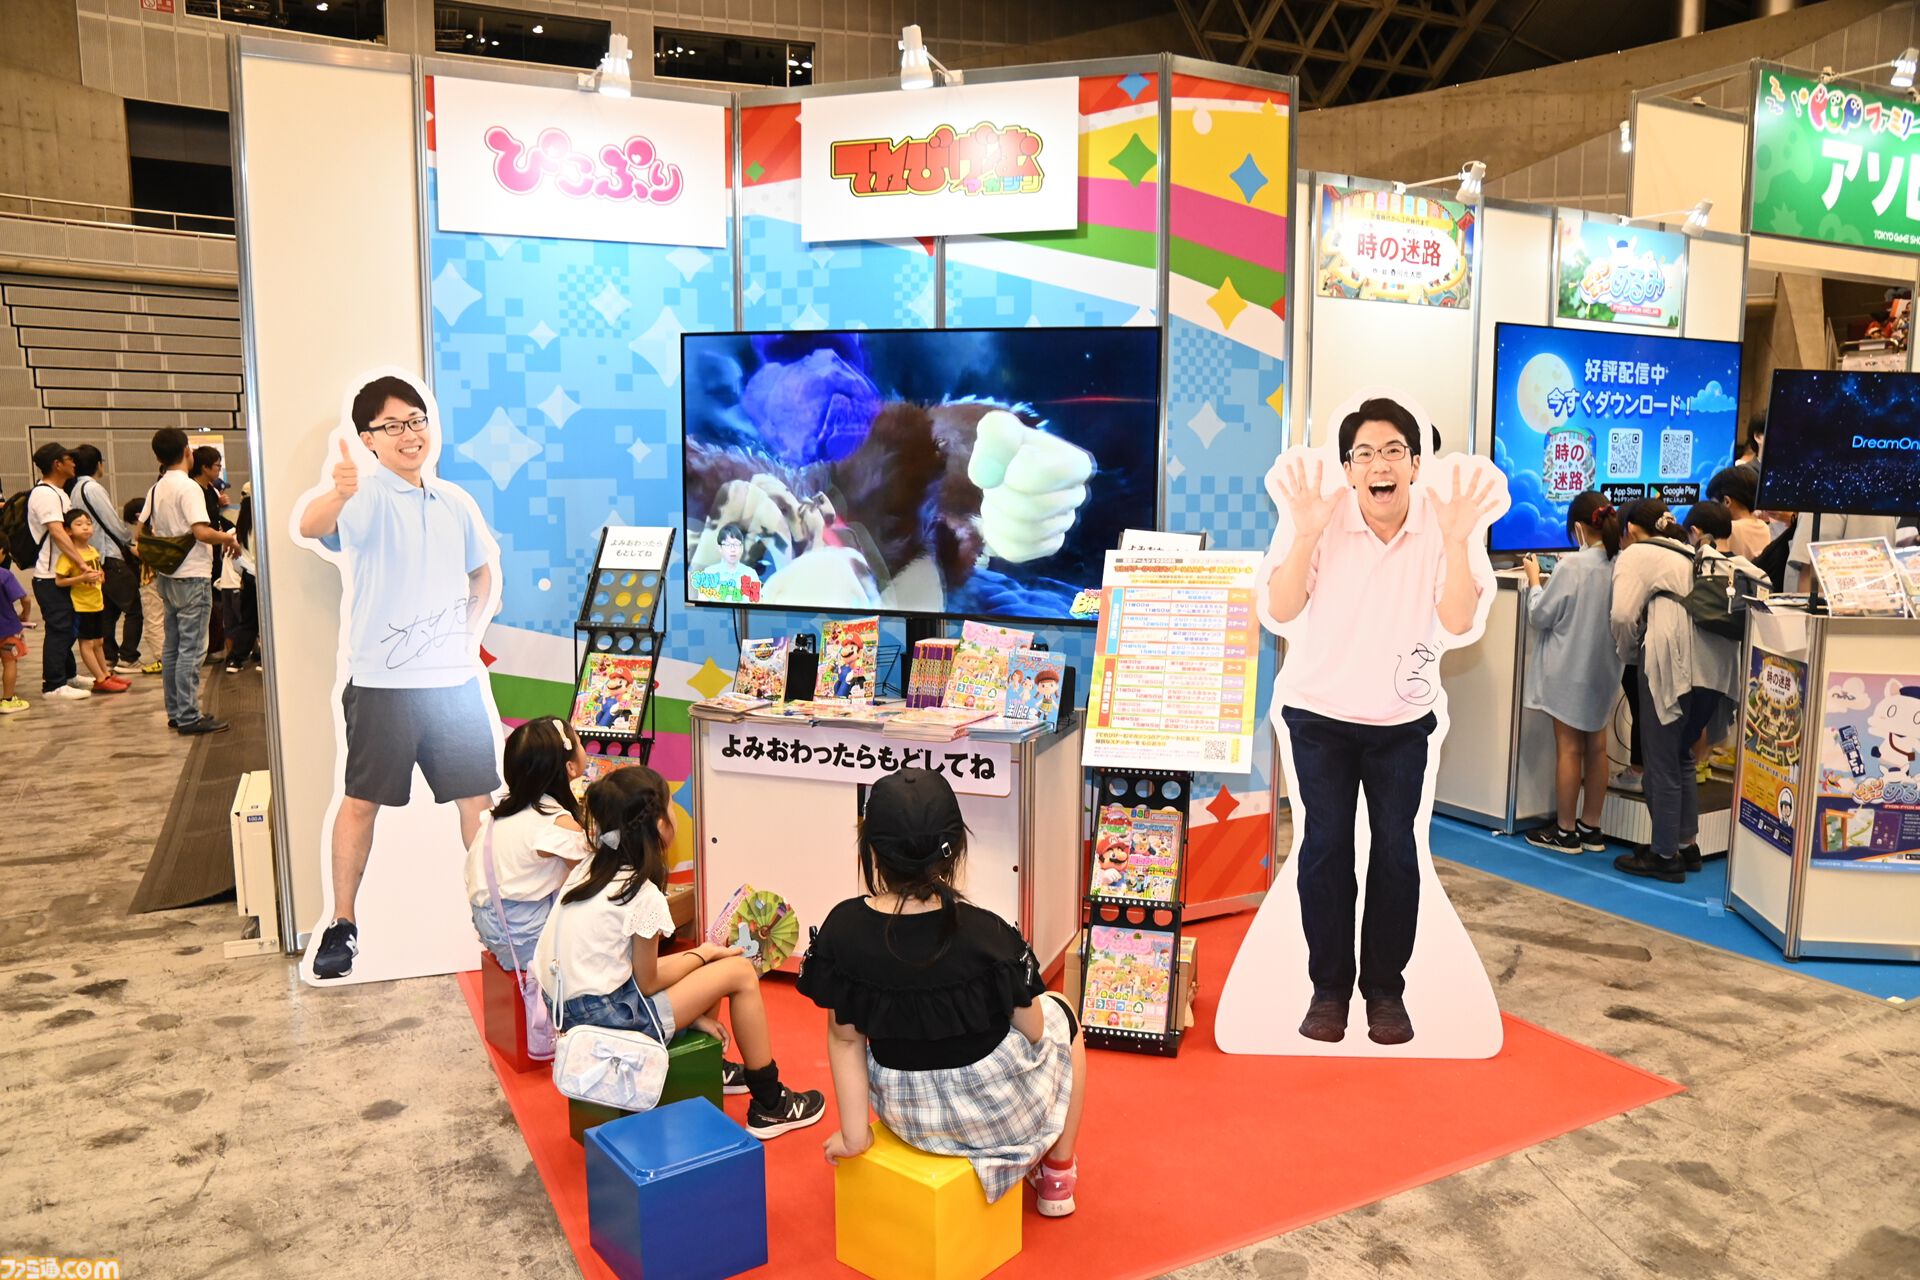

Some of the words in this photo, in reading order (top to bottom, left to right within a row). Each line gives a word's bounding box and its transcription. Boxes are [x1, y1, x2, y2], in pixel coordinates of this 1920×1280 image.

[485, 126, 684, 205] ぴこぷり
[1873, 229, 1894, 242] TOKYO
[1893, 232, 1910, 244] GAME
[1357, 232, 1442, 267] 時の迷路
[1585, 358, 1666, 386] 好評配信中
[1547, 388, 1692, 417] 今すぐダウンロード！
[1555, 443, 1585, 462] 時の
[1852, 435, 1920, 450] DreamOn
[1553, 471, 1583, 491] 迷路
[1663, 485, 1684, 497] Google
[1685, 485, 1697, 497] Play
[1614, 487, 1626, 497] App
[1627, 486, 1642, 496] Store
[610, 538, 664, 548] よみおわったら
[1766, 670, 1792, 691] 時の迷路
[721, 734, 996, 779] よみおわったらもどしてね
